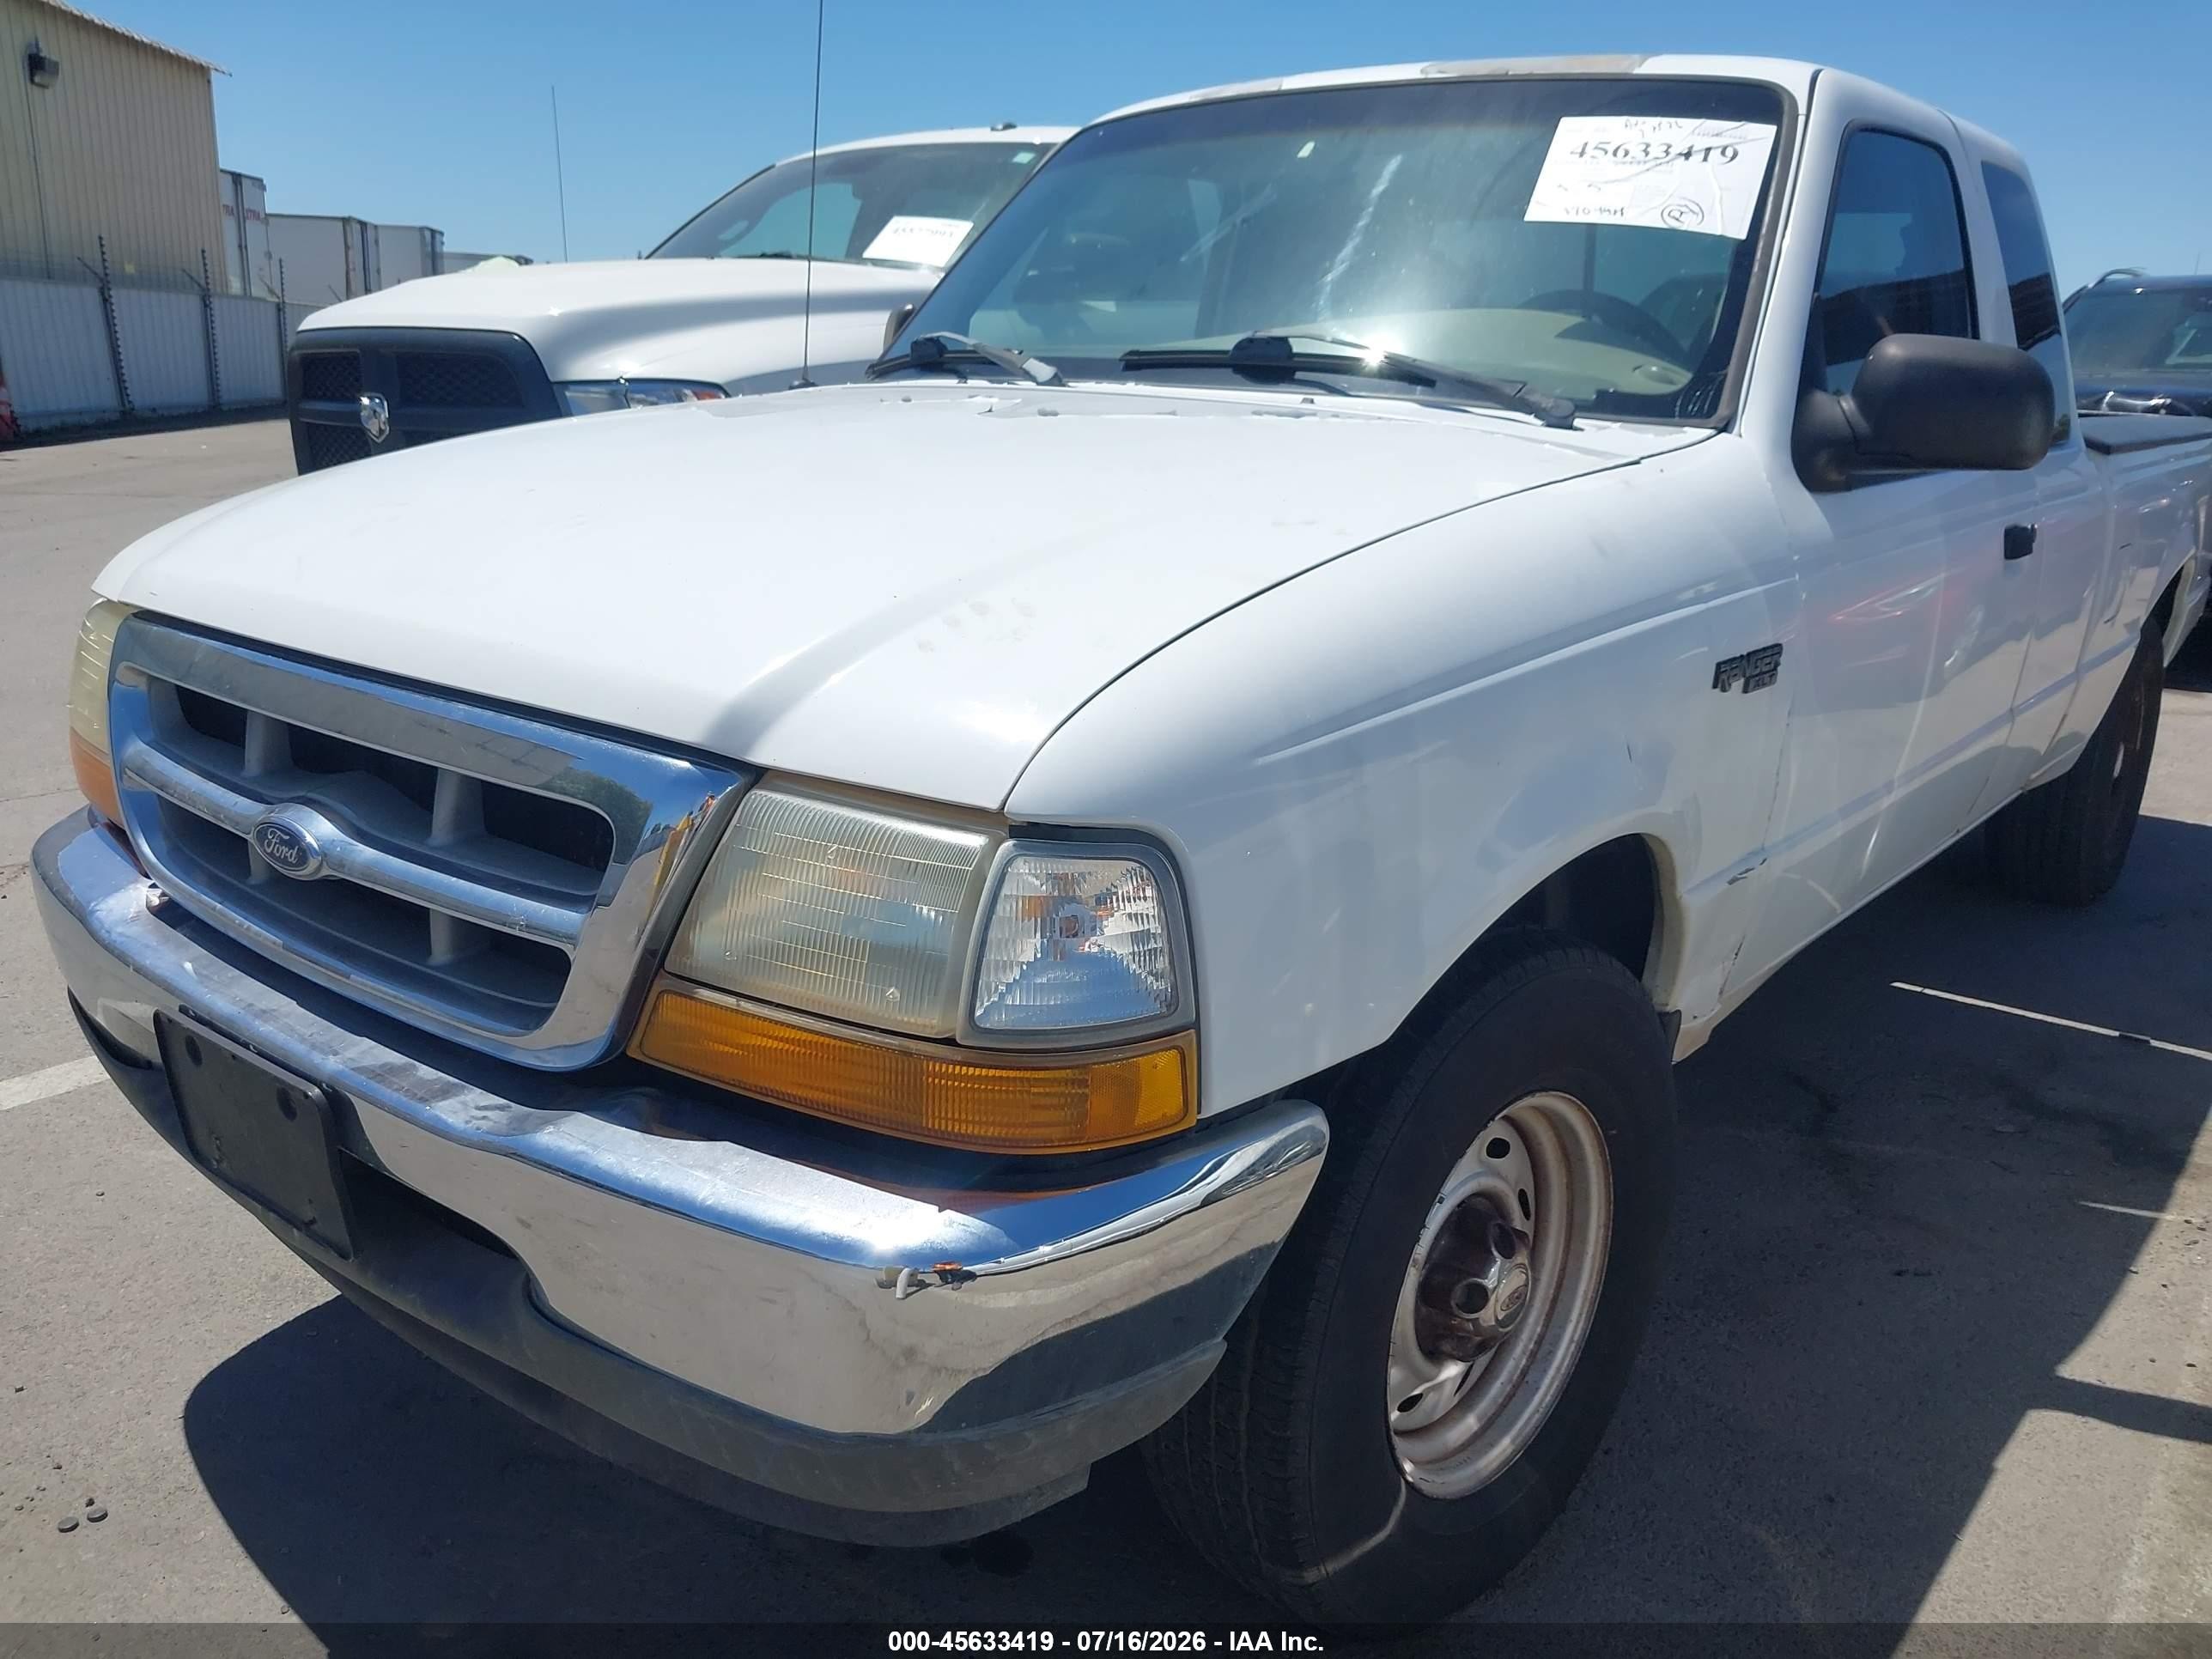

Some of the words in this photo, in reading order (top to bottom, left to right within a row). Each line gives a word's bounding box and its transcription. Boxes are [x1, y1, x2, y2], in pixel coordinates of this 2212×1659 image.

[1570, 141, 1740, 165] 45633419
[1742, 672, 1778, 694] XLT
[264, 828, 299, 864] Ford
